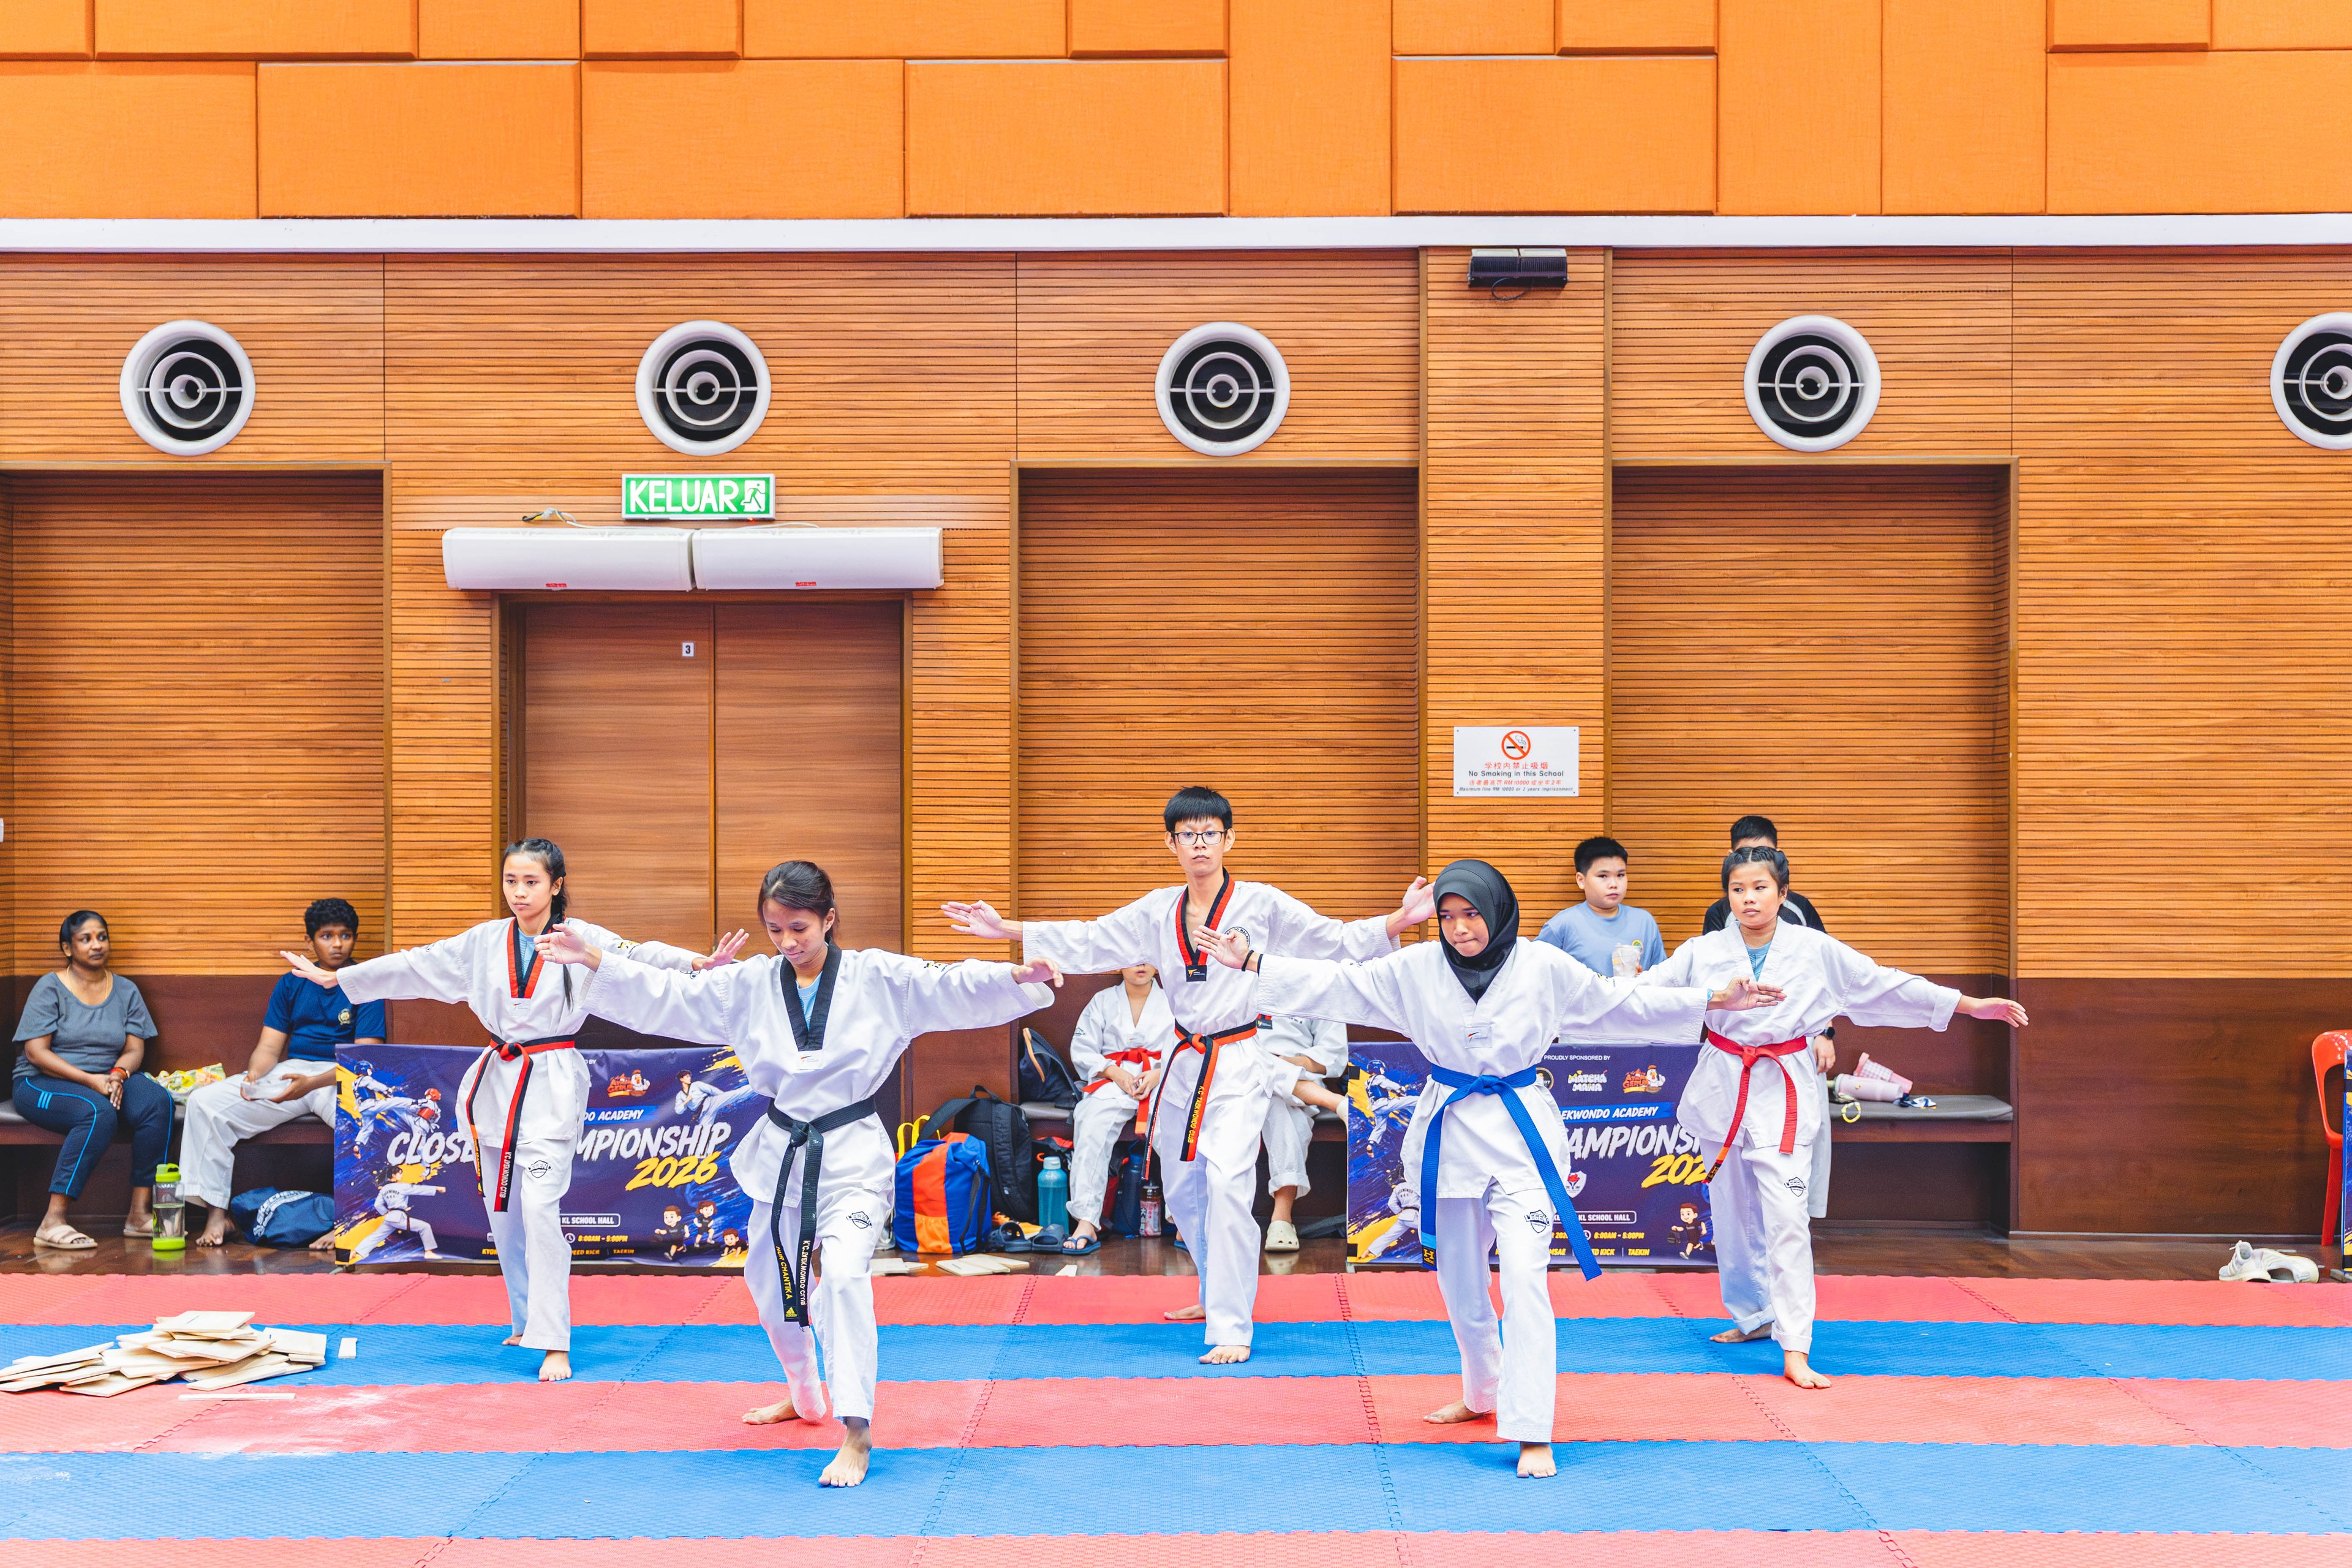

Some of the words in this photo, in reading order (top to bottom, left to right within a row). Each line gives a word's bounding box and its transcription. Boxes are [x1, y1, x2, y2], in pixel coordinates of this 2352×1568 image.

[630, 480, 739, 512] KELUAR
[685, 645, 691, 654] 3
[1485, 761, 1548, 770] 学校内禁止吸烟
[1568, 1072, 1607, 1084] MATCHA
[597, 1109, 644, 1121] ACADEMY
[1191, 1096, 1203, 1128] TAEKWONDO
[1560, 1109, 1610, 1120] EKWONDO
[1612, 1106, 1659, 1118] ACADEMY
[386, 1132, 475, 1165] CLOSE
[576, 1121, 731, 1162] MPIONSHIP
[1567, 1123, 1700, 1159] AMPIONS
[625, 1151, 722, 1191] 2026
[1641, 1153, 1707, 1188] 202
[775, 1246, 785, 1261] NUR
[780, 1262, 793, 1300] CHANTIKA
